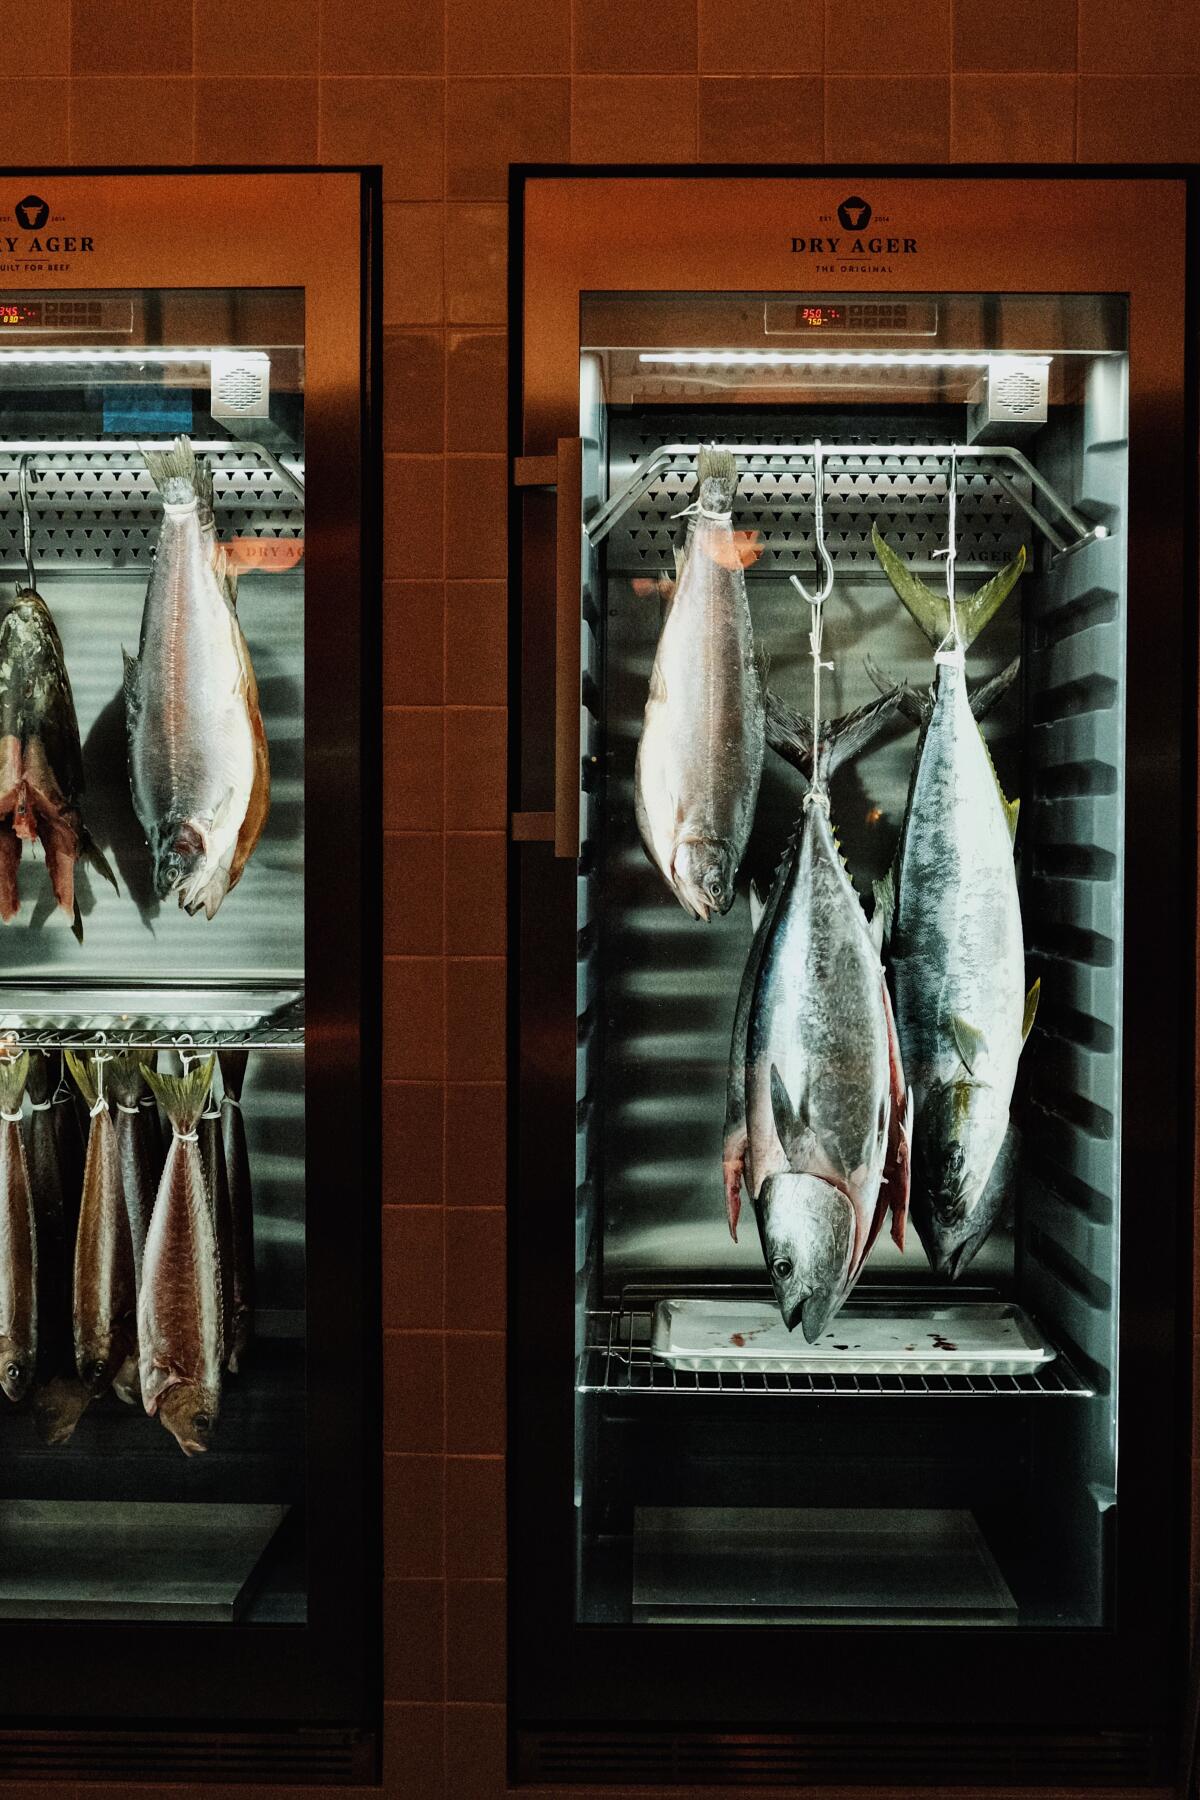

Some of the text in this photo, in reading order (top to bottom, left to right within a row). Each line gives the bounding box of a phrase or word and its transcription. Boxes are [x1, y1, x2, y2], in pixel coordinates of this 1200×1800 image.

[0, 236, 94, 252] Y AGER
[791, 237, 918, 253] DRY AGER
[816, 265, 893, 273] THE ORIGINAL
[246, 547, 280, 557] DRY
[967, 551, 1013, 561] AGER
